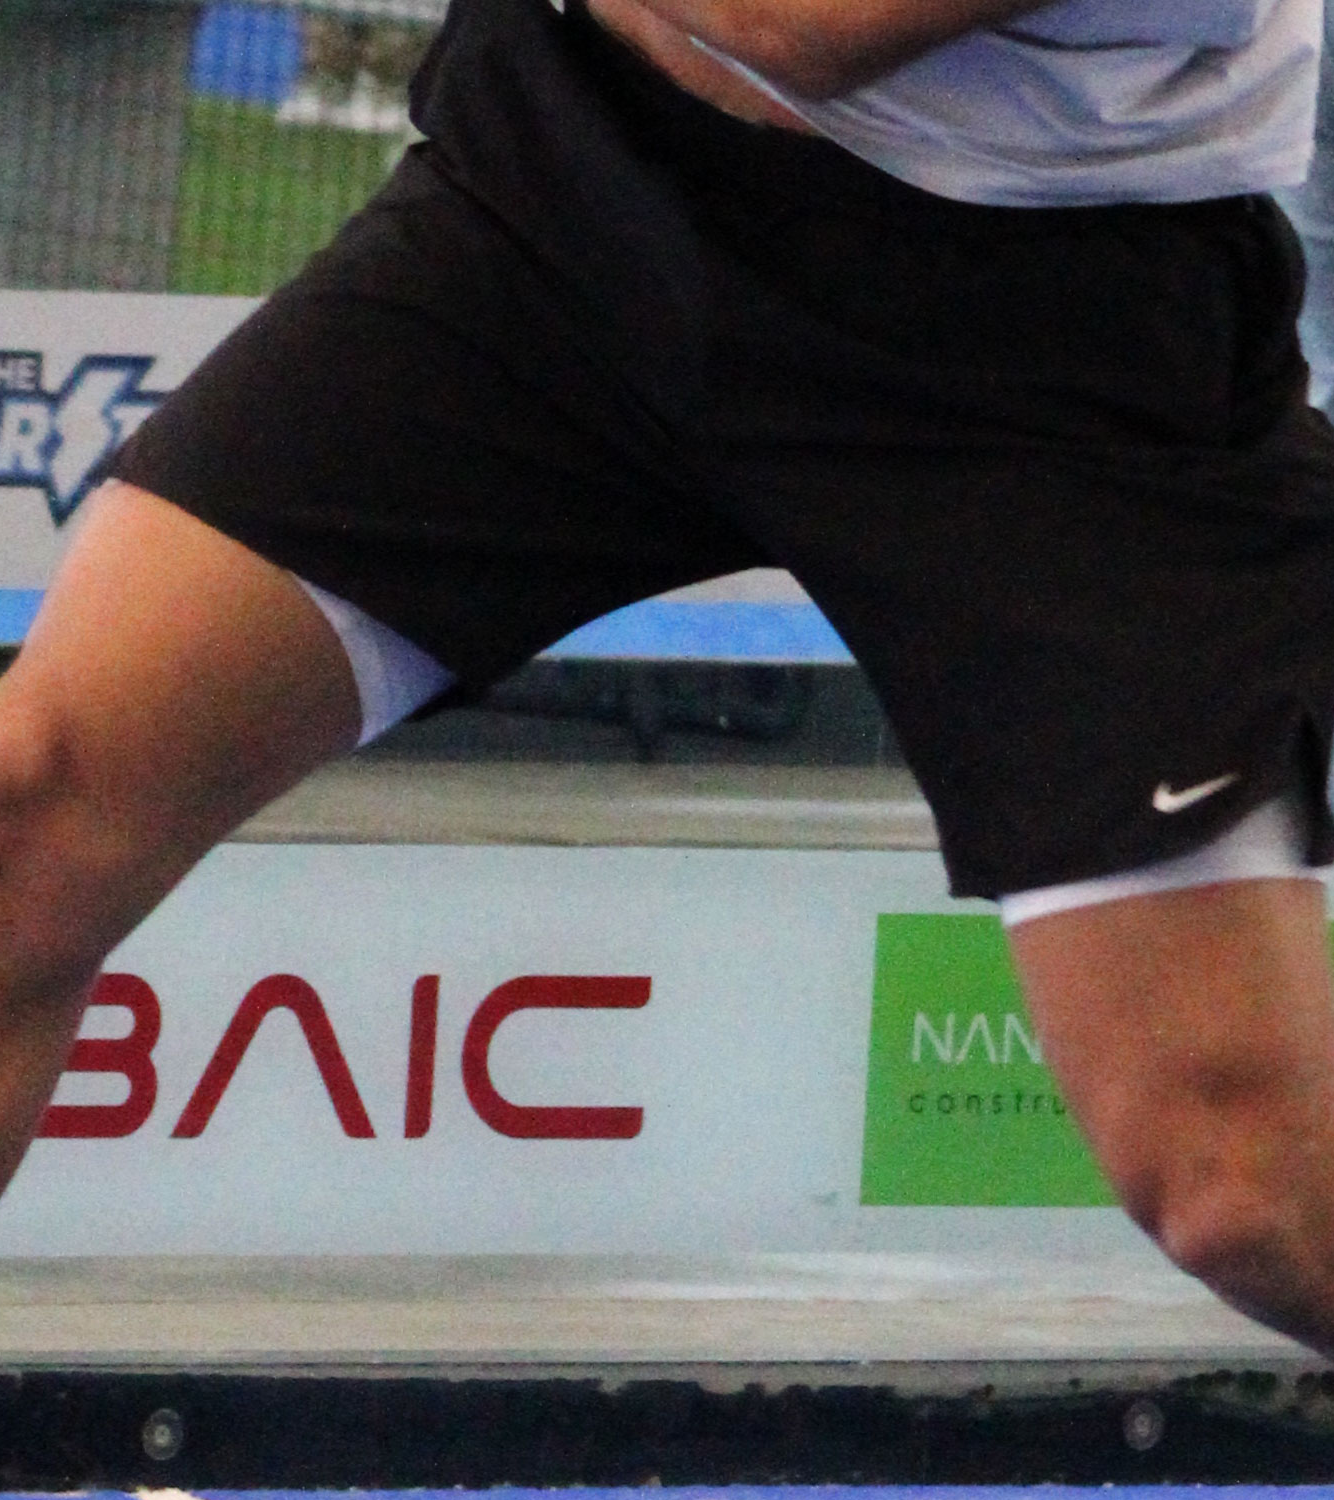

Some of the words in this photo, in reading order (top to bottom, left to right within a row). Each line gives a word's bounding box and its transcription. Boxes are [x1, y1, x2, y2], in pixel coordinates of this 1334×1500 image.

[35, 973, 654, 1139] BAIC
[909, 1011, 1043, 1065] NAN
[908, 1090, 1067, 1116] constru
